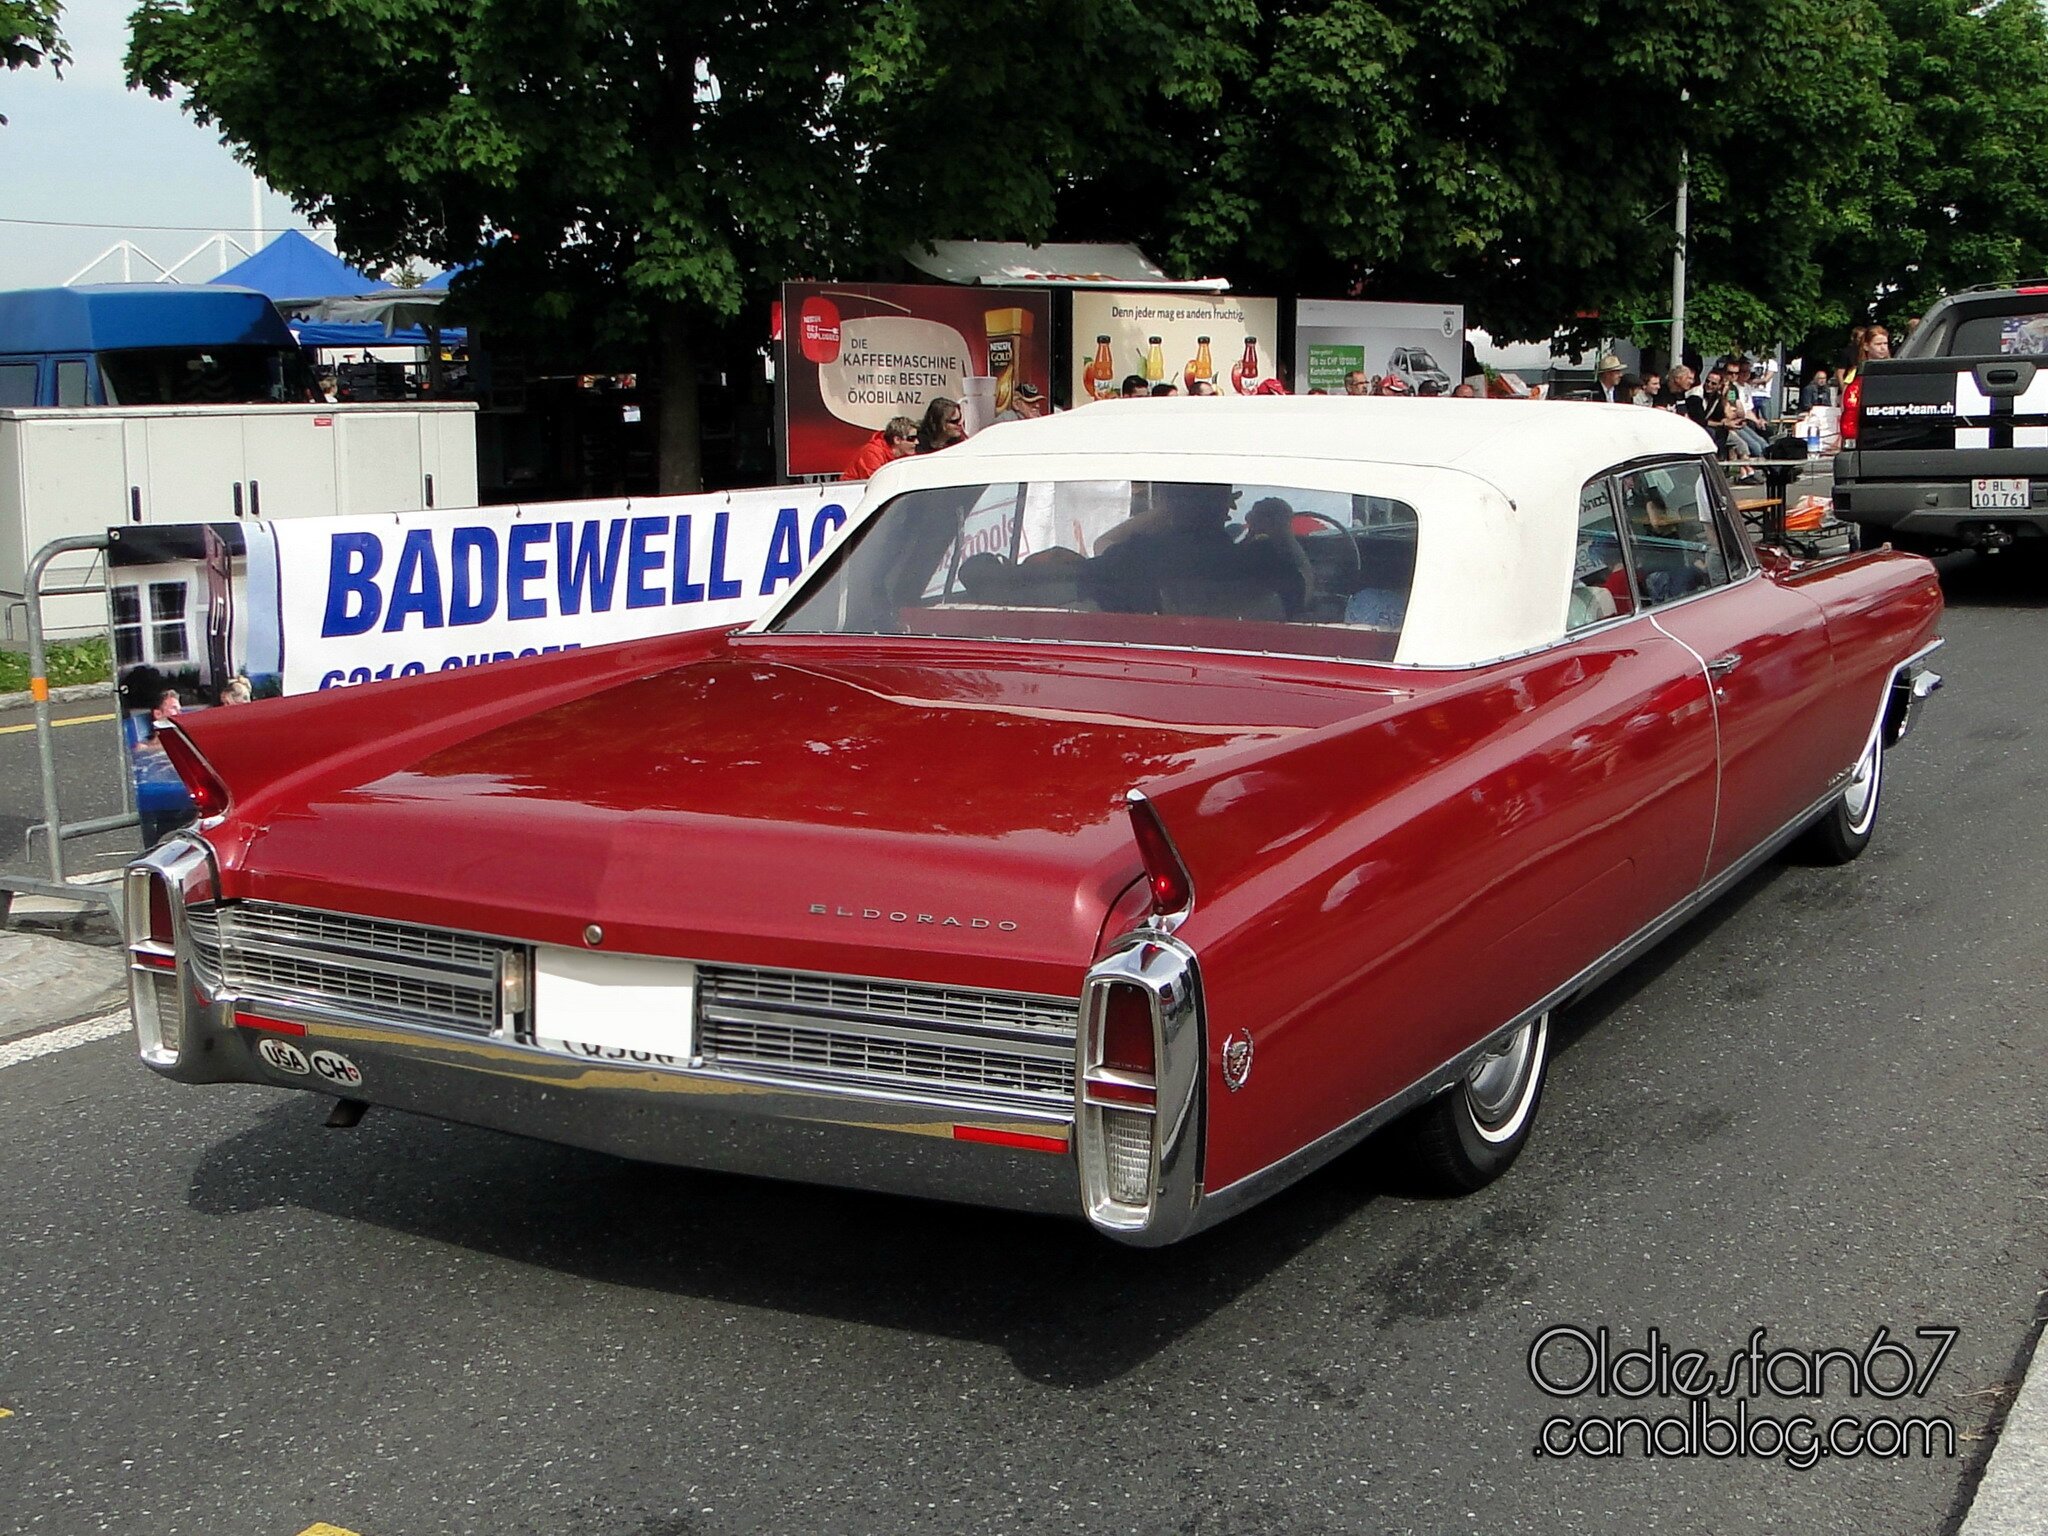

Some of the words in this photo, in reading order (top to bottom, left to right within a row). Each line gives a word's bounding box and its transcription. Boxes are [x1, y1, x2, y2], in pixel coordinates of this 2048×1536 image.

[1112, 306, 1134, 318] Denn
[1135, 306, 1156, 320] jeder
[1157, 309, 1174, 321] mag
[1176, 309, 1185, 319] es
[1186, 308, 1212, 320] anders
[851, 339, 868, 349] DIE
[843, 353, 956, 370] KAFFEEMASCHINE
[991, 352, 1012, 362] GOLD
[857, 374, 874, 385] MIT
[877, 374, 897, 385] DER
[900, 372, 947, 386] BESTEN
[848, 387, 925, 405] ÖKOBILANZ.
[1866, 401, 1954, 416] us-cars-team.ch
[1993, 481, 2006, 491] BL
[321, 511, 742, 638] BADEWELL
[809, 903, 1018, 931] ELDORADO
[265, 1045, 306, 1070] USA
[313, 1056, 354, 1081] CH
